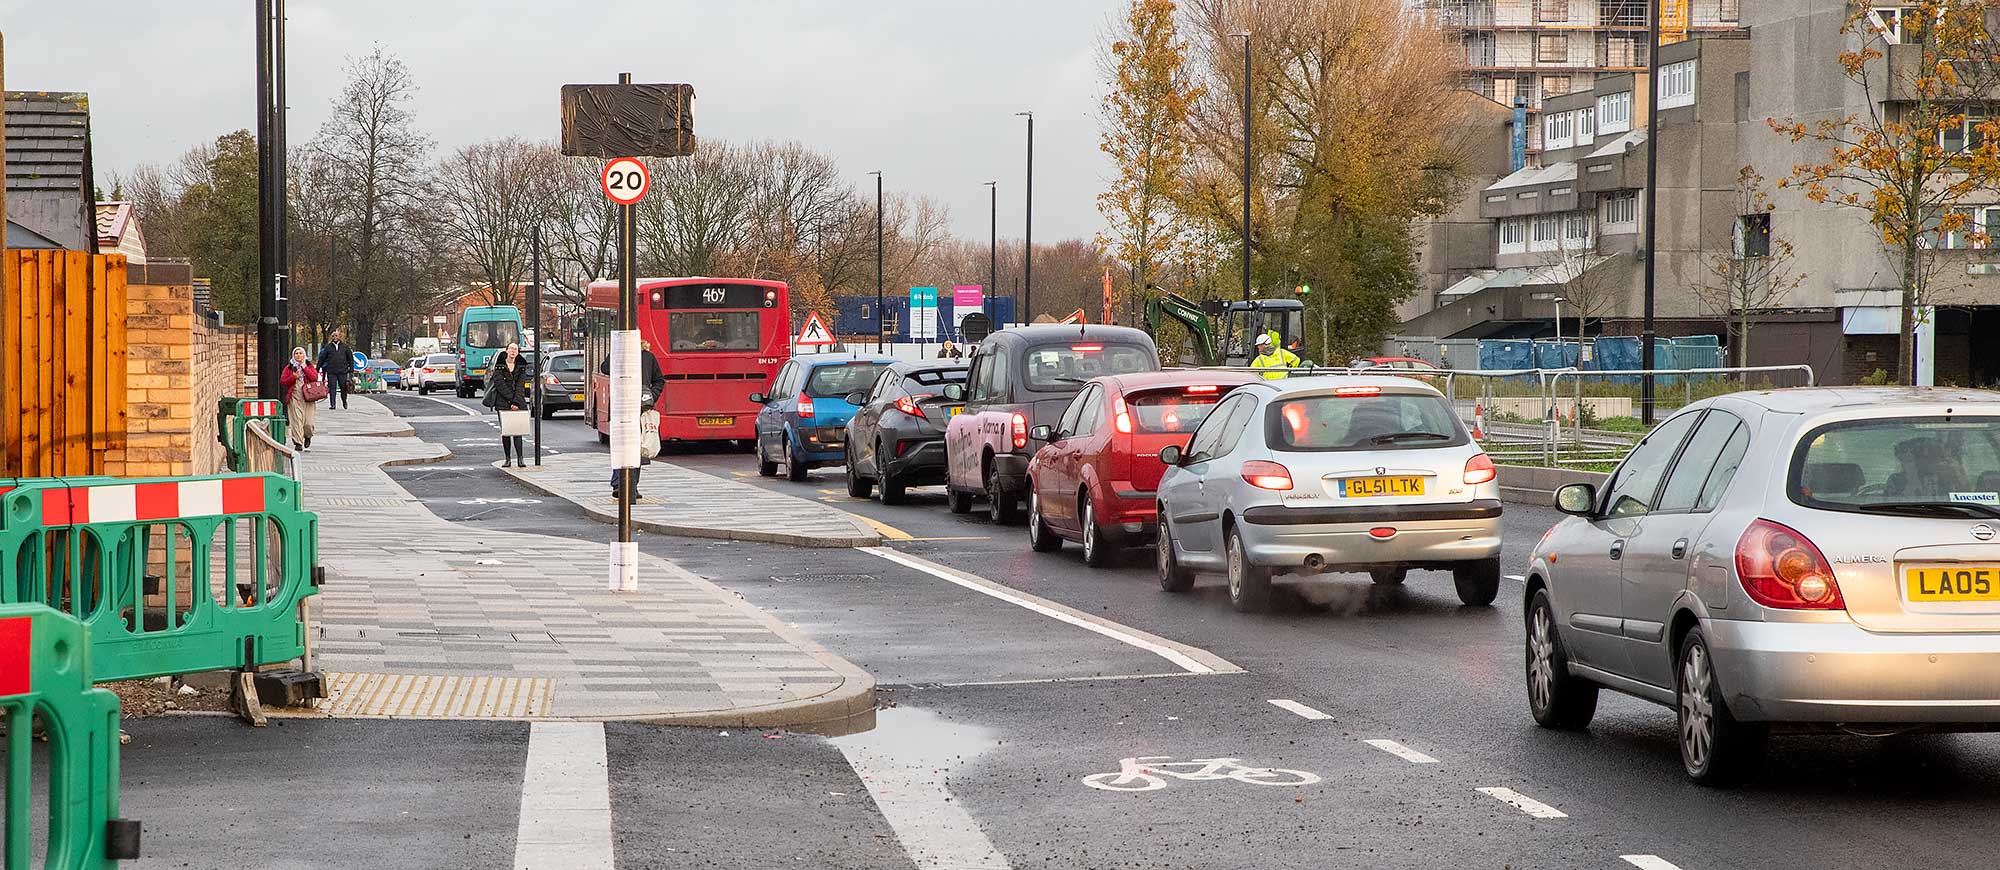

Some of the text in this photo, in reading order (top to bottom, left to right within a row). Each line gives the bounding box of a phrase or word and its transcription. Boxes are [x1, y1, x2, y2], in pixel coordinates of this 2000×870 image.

[609, 170, 643, 191] 20
[1177, 307, 1199, 323] CONWAY
[1353, 480, 1386, 494] GL51
[1390, 479, 1419, 493] LTK
[1952, 493, 1996, 502] Ancaster
[1833, 554, 1887, 564] ALMERA
[1919, 571, 1990, 595] LA05
